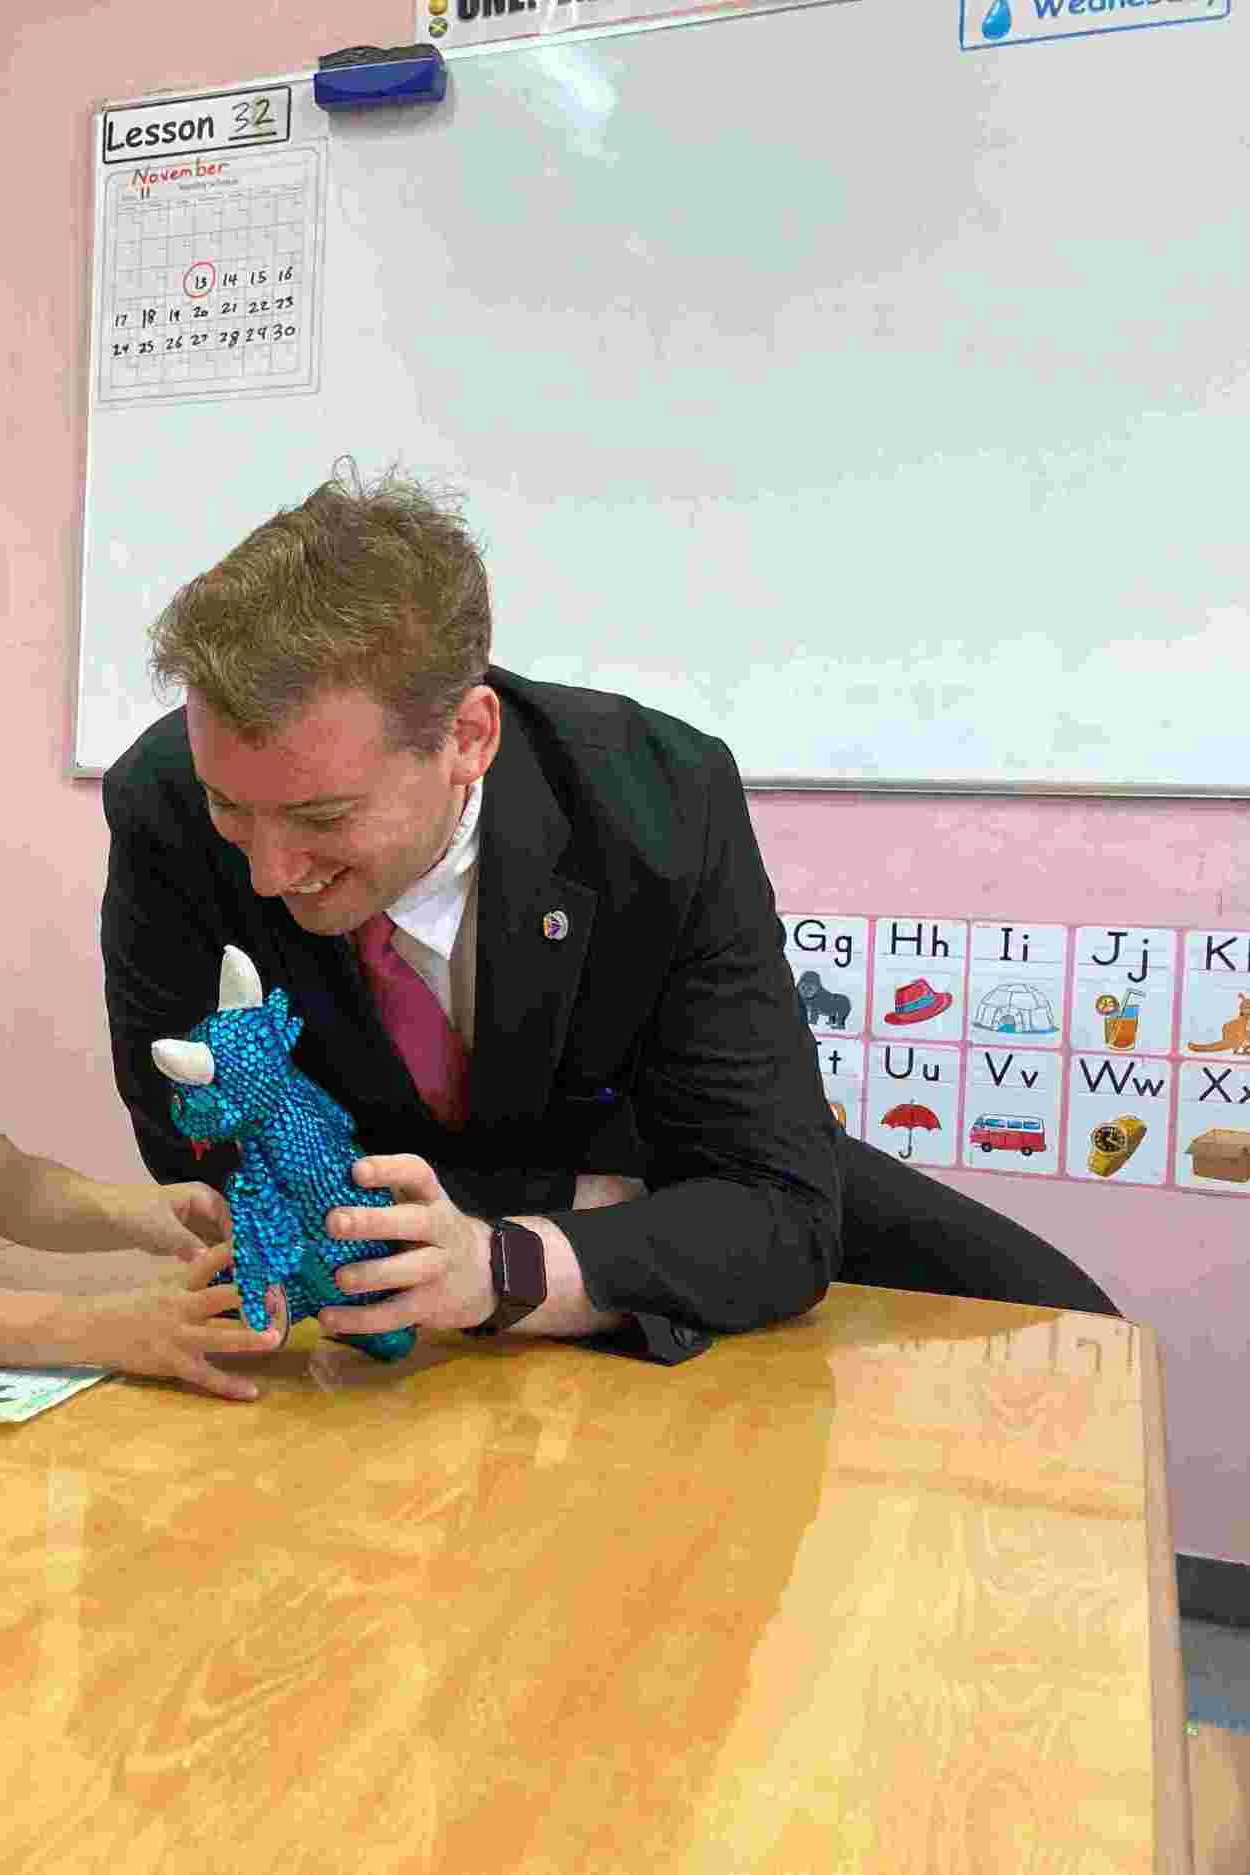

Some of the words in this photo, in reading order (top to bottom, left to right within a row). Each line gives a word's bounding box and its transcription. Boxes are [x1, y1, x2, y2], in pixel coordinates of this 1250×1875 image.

[106, 113, 215, 152] Lesson
[231, 95, 276, 133] 32
[132, 157, 228, 186] November
[195, 276, 208, 290] 13
[222, 273, 239, 287] 14
[250, 270, 268, 285] 15
[278, 266, 294, 282] 16
[115, 314, 128, 327] 17
[142, 308, 157, 328] 18
[169, 309, 181, 322] 19
[193, 306, 209, 319] 20
[221, 302, 238, 315] 21
[249, 300, 270, 314] 22
[276, 296, 294, 310] 23
[112, 343, 130, 356] 24
[138, 341, 154, 354] 25
[166, 336, 183, 350] 26
[190, 333, 209, 346] 27
[219, 330, 239, 348] 28
[245, 328, 267, 343] 29
[272, 323, 296, 342] 30
[793, 919, 854, 969] Gg
[890, 921, 951, 959] Hh
[1091, 931, 1151, 984] Jj
[884, 1046, 941, 1082] Uu
[1079, 1058, 1165, 1098] Ww
